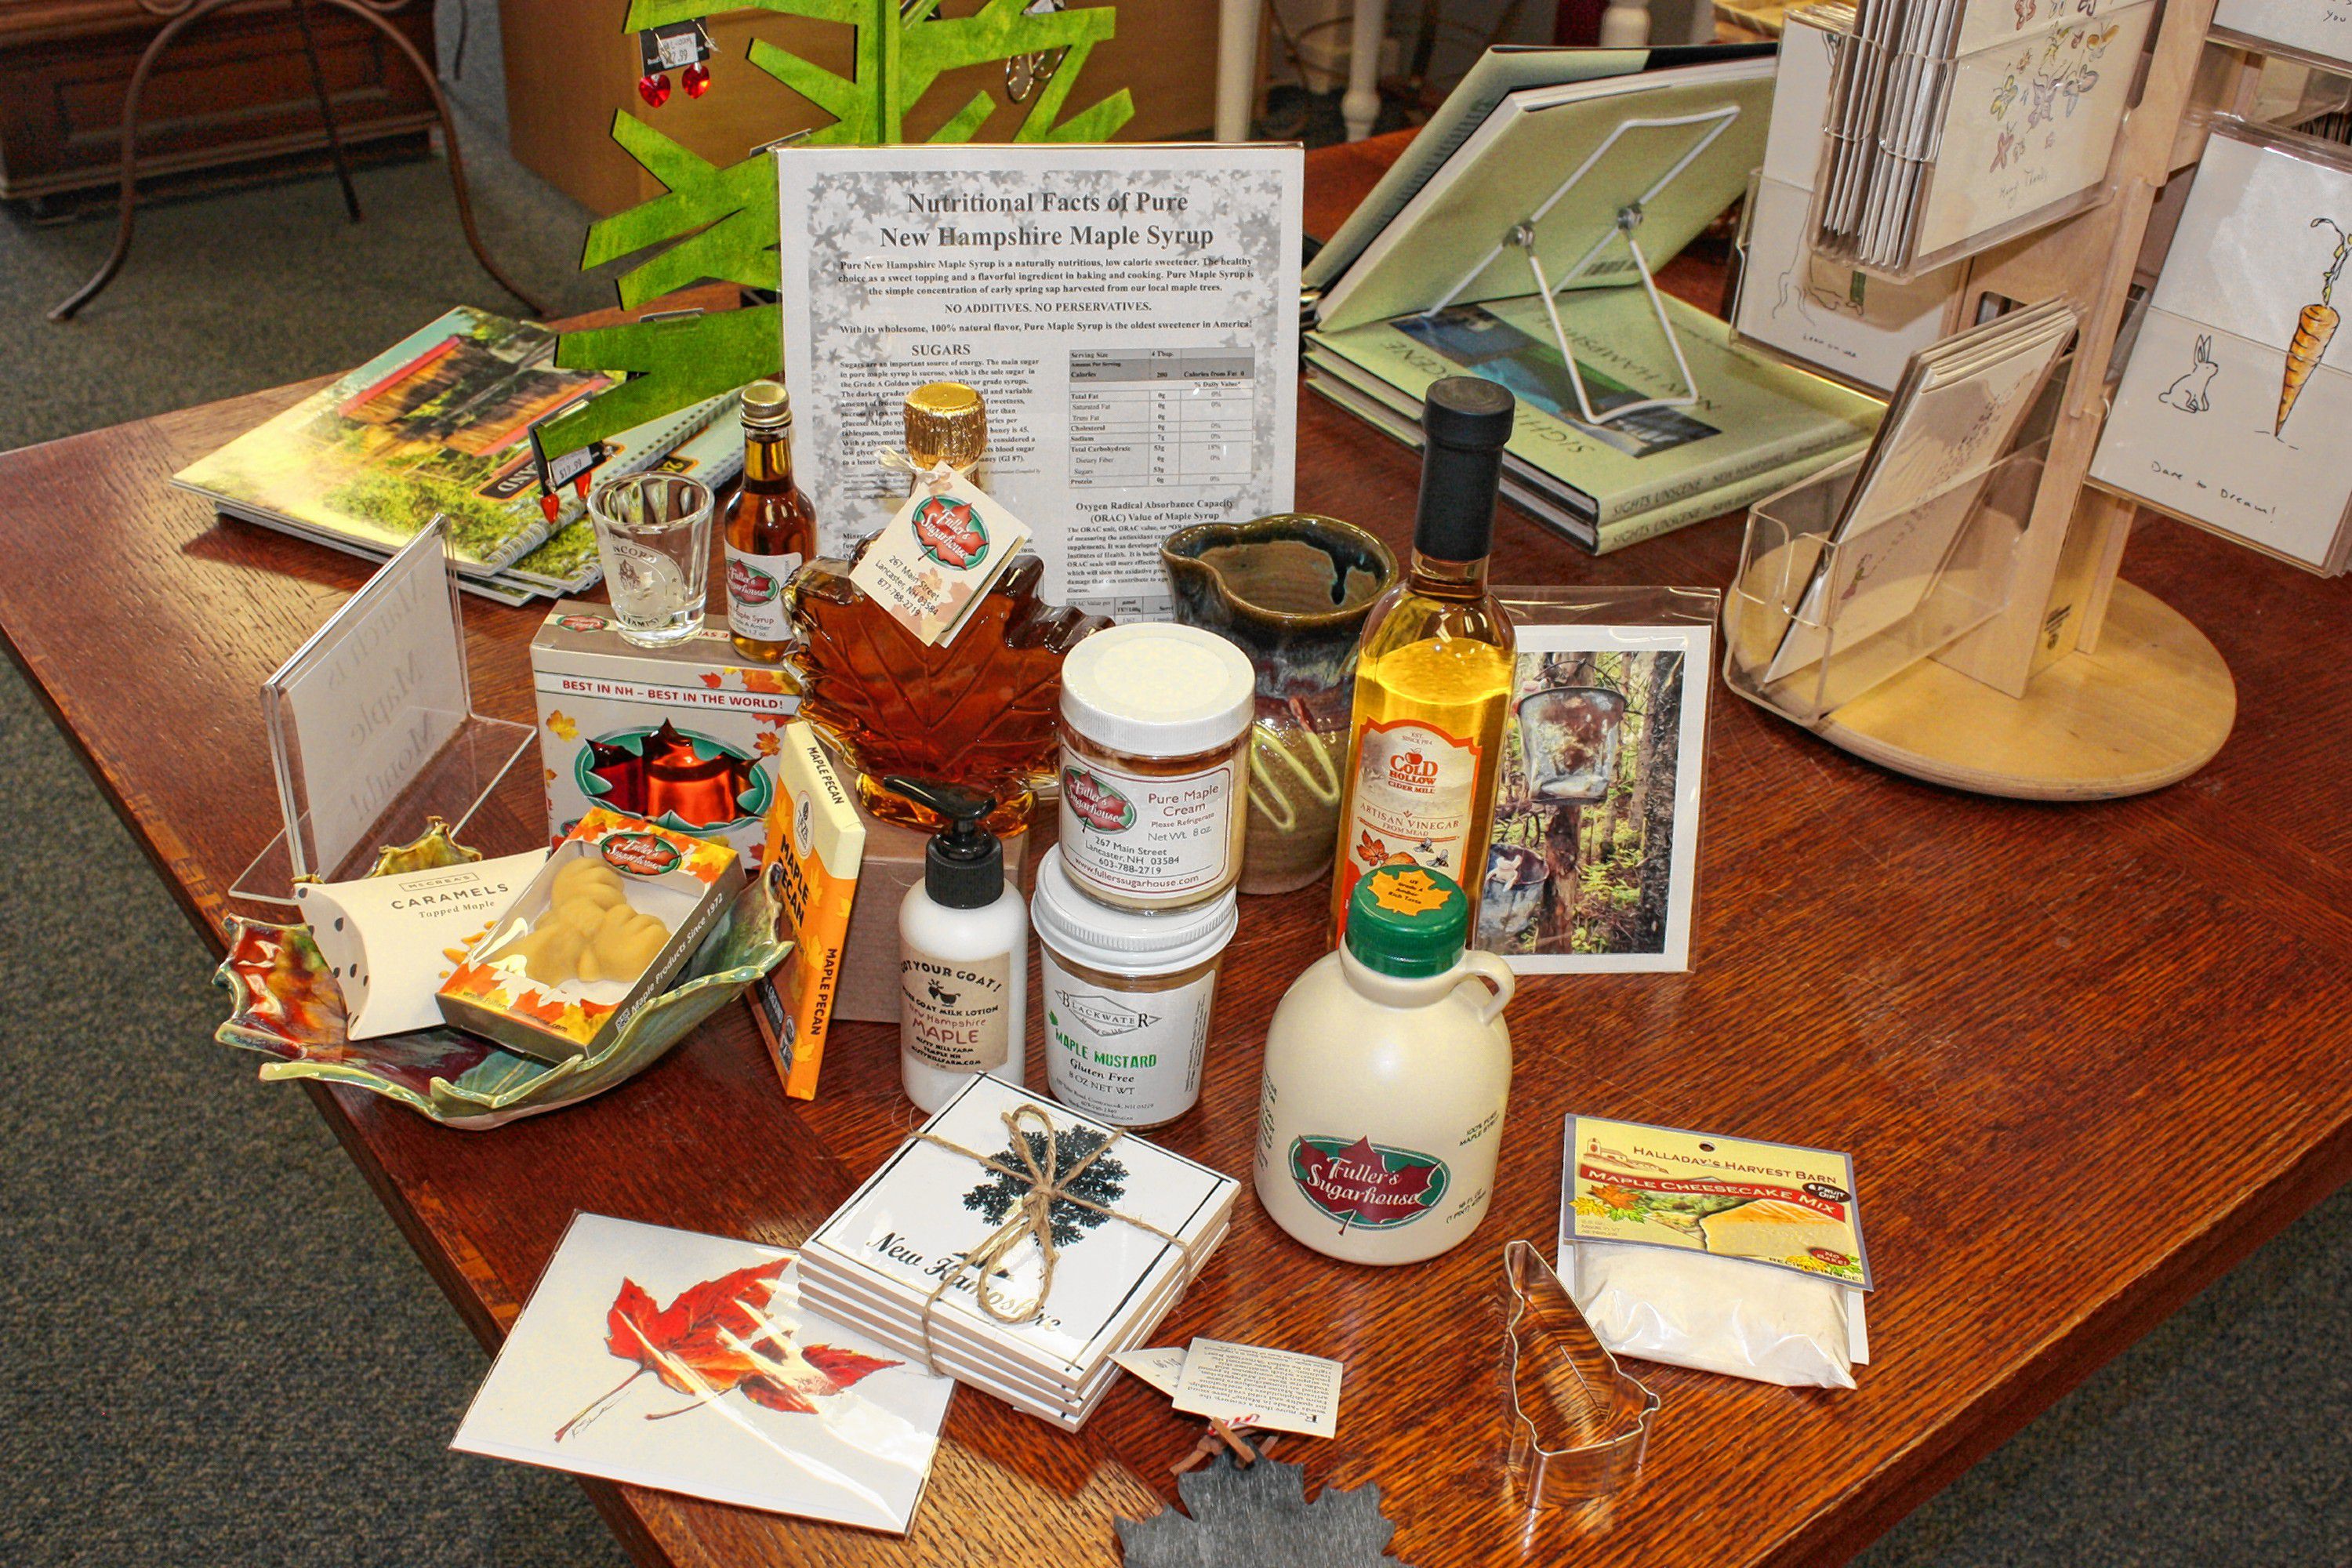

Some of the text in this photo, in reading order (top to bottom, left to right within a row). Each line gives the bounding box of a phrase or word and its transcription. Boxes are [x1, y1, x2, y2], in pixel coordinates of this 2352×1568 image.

[906, 191, 1189, 214] Nutritional Facts of Pure
[880, 225, 1214, 252] New Hampshire Maple Syrup
[840, 260, 861, 269] Pure
[864, 261, 883, 270] New
[886, 260, 935, 271] Hampshire
[938, 260, 967, 270] Maple
[969, 260, 996, 270] Syrup
[1015, 259, 1054, 270] naturally
[1058, 259, 1104, 267] nutritious,
[1123, 258, 1153, 267] calorie
[1220, 256, 1252, 268] healthy
[885, 286, 914, 297] simple
[916, 285, 977, 295] concentration
[979, 285, 989, 294] of
[990, 285, 1013, 296] early
[1014, 285, 1044, 296] spring
[1045, 286, 1061, 295] sap
[1062, 284, 1105, 292] harvested
[1107, 284, 1128, 292] from
[1148, 283, 1169, 292] local
[1171, 283, 1198, 294] maple
[945, 301, 1152, 314] NO ADDITIVES. NO PERSERVATIVES.
[911, 344, 971, 356] SUGARS
[2151, 460, 2278, 524] Dare to Dream!
[1076, 499, 1236, 513] Oxygen Radical Absorbance Capacity
[1090, 510, 1127, 524] (ORAC)
[1165, 512, 1192, 522] Maple
[1193, 507, 1222, 524] Syrup
[920, 512, 970, 560] Sugarhouse
[936, 508, 971, 541] Fuller's
[888, 555, 940, 602] 267 Main Street
[877, 577, 921, 617] 877-788-2719
[906, 585, 919, 600] NH
[916, 596, 939, 616] 03584
[752, 615, 775, 625] Syrup
[562, 680, 784, 710] BEST IN NH BEST IN THE WORLD!
[807, 746, 844, 805] MAPLE PECAN
[1388, 770, 1437, 785] HOLLOW
[1390, 753, 1439, 777] COLD
[1073, 779, 1108, 808] Fuller's
[1148, 784, 1220, 805] Pure Maple
[1388, 780, 1436, 795] CIDER MILL
[1068, 787, 1120, 824] Sugarhouse
[1163, 802, 1207, 818] Cream
[1360, 801, 1461, 830] ARTISAN VINEGAR
[1151, 811, 1216, 829] Please Refrigerate
[1381, 822, 1429, 837] FROM MEAD
[1094, 836, 1167, 857] 267 Main Street
[1148, 832, 1167, 842] Net
[1168, 832, 1187, 841] Wt.
[1192, 828, 1200, 837] 8
[1084, 840, 1180, 866] Lancaster, NH 03584
[1098, 857, 1163, 876] 603-788-2719
[780, 834, 809, 906] MAPLE
[1074, 857, 1200, 889] www.fullerssugarhouse.com
[391, 883, 510, 910] CARAMELS
[418, 899, 495, 919] Tapped Maple
[630, 891, 724, 1015] Maple Products Since 1972
[913, 960, 953, 978] YOUR
[956, 970, 1003, 993] GOAT!
[811, 948, 838, 1036] MAPLE PECAN
[916, 996, 1000, 1017] GOAT MILK LOTION
[1060, 989, 1150, 1029] BLACKWATER
[912, 1018, 980, 1045] MAPLE
[927, 1014, 987, 1029] Hampshire
[1054, 1027, 1157, 1069] MAPLE MUSTARD
[1069, 1058, 1135, 1083] Gluten Free
[1069, 1070, 1136, 1095] 8 OZ NET WT
[1326, 1156, 1401, 1186] Fuller's
[1633, 1146, 1838, 1185] HALLADAY'S HARVEST BARN
[1306, 1163, 1423, 1207] Sugarhouse
[1588, 1168, 1836, 1215] MAPLE CHEESECAKE MIX
[866, 1232, 924, 1269] New
